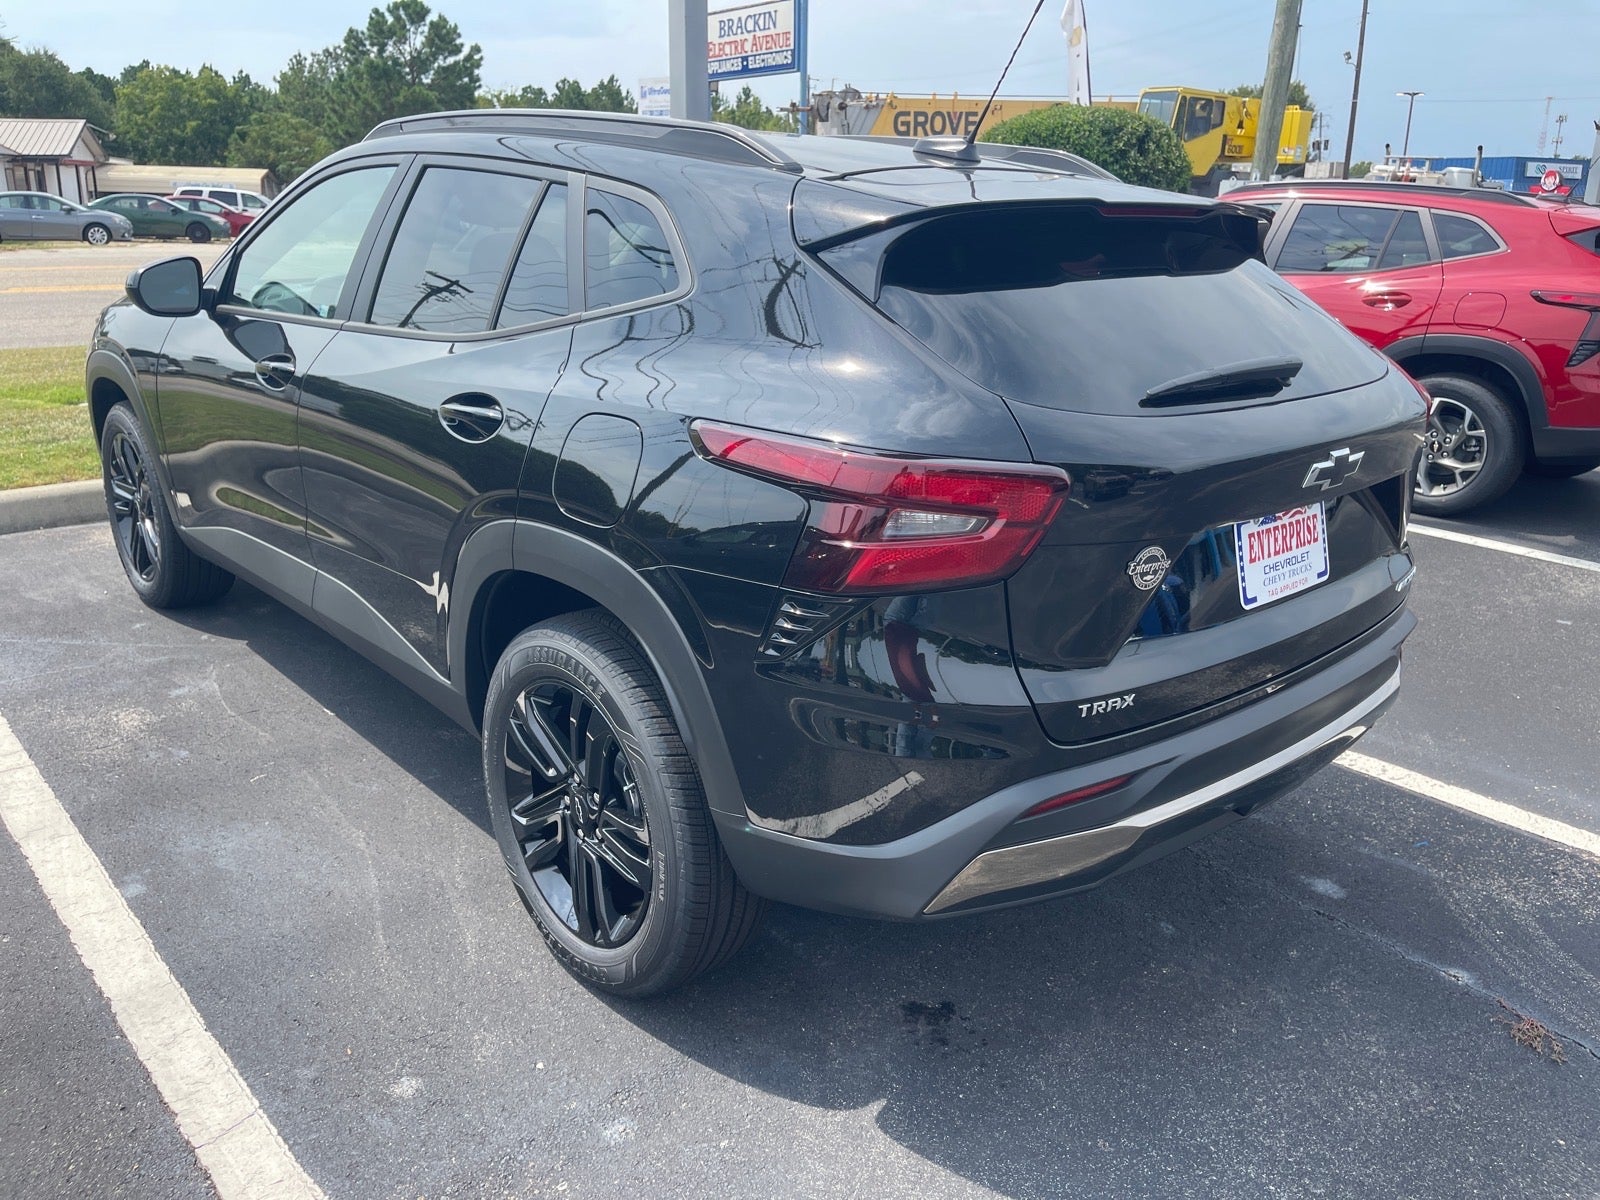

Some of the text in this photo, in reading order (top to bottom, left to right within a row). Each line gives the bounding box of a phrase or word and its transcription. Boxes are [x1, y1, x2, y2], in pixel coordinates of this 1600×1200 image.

[718, 10, 778, 38] BRACKIN
[708, 32, 791, 59] ELECTRIC AVENUE
[748, 50, 792, 69] ELECTRONICS
[893, 110, 979, 136] GROVE
[1247, 513, 1319, 564] ENTERPRISE
[1129, 559, 1172, 576] Enterprise
[1263, 551, 1310, 575] CHEVROLET
[1263, 562, 1313, 587] CHEVY TRUCKS
[1268, 577, 1309, 597] TAG APPLIED FOR
[1078, 693, 1136, 718] TRAX
